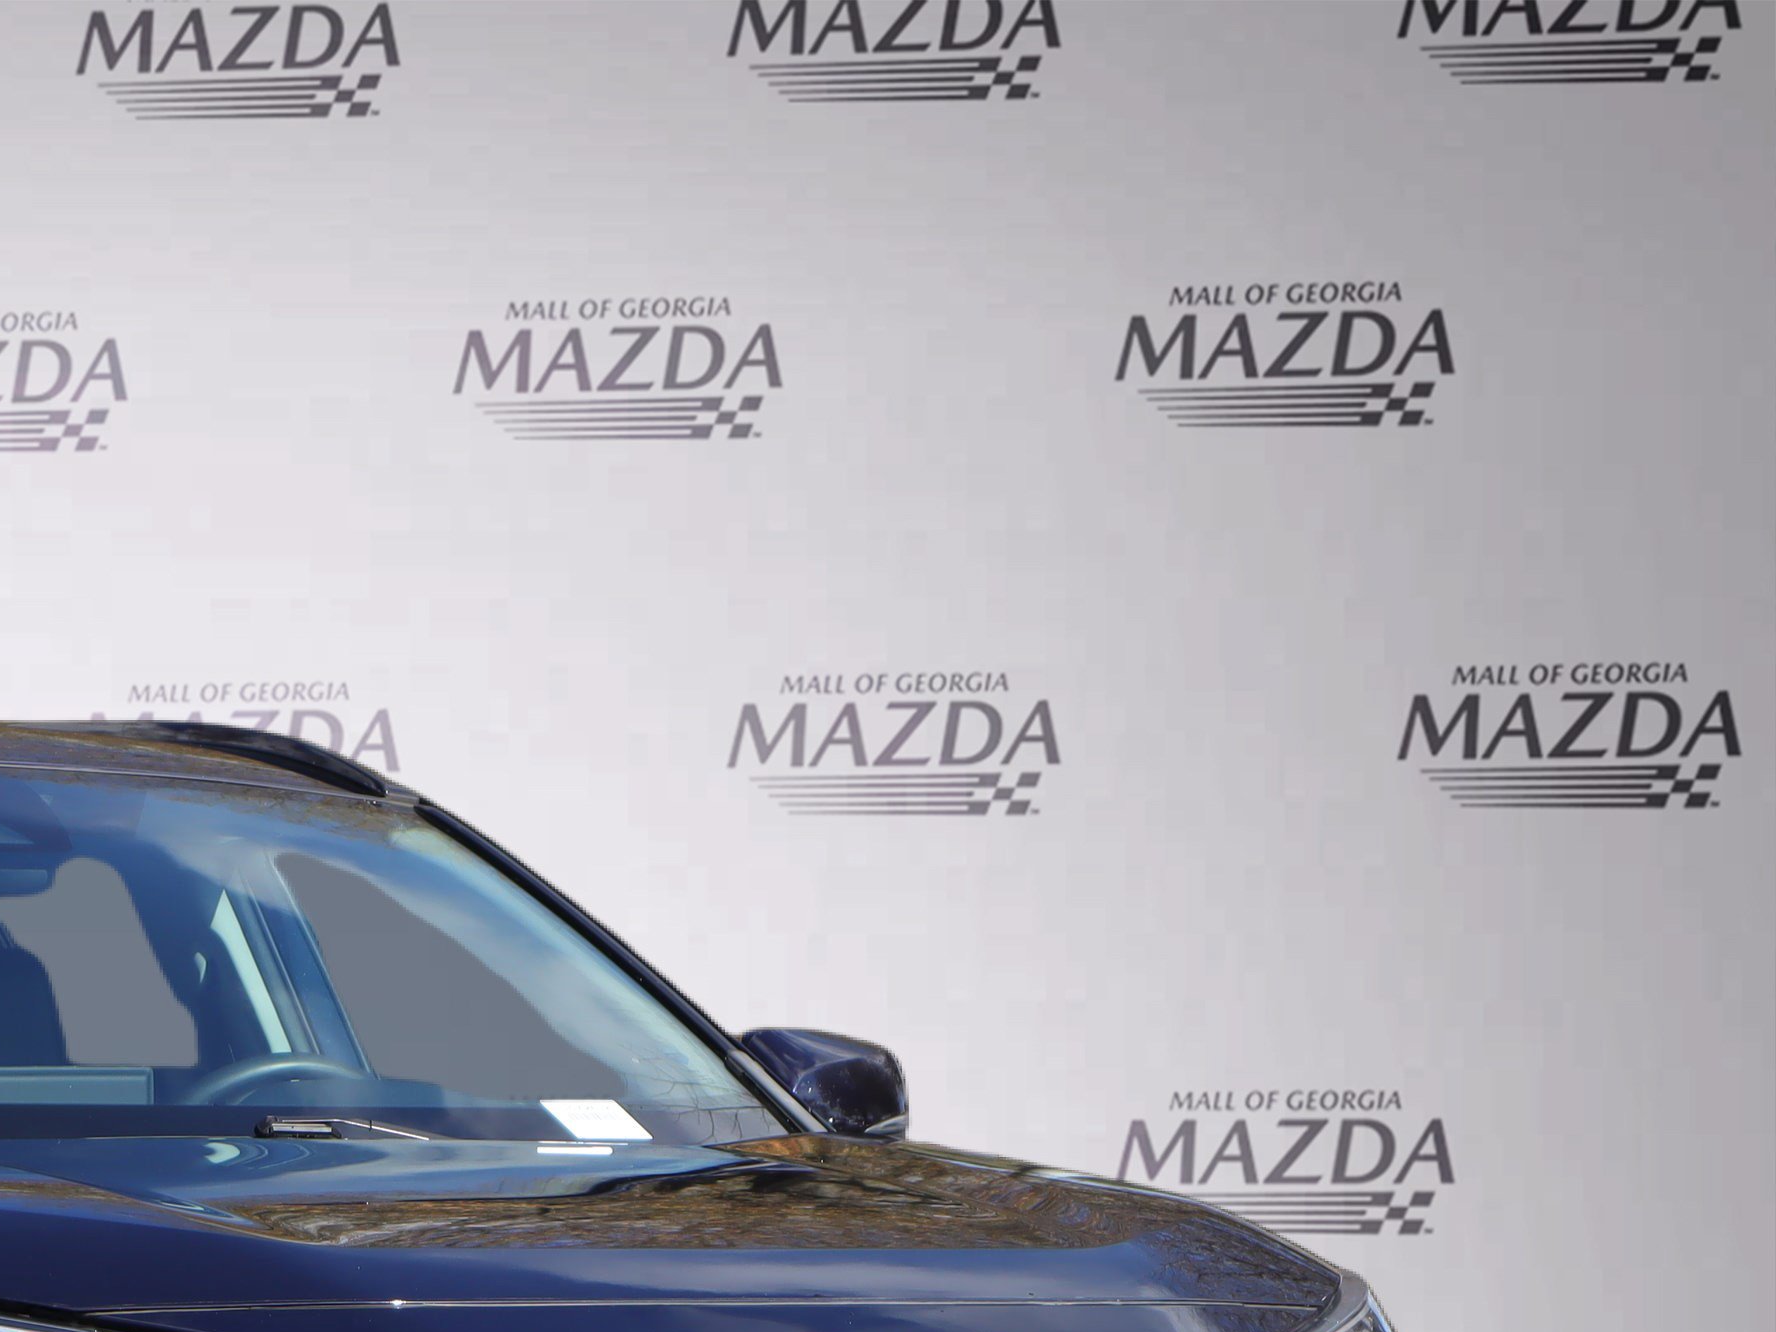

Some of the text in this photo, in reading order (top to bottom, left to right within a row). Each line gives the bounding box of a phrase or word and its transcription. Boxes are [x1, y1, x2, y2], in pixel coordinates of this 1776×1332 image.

[76, 3, 401, 75] MAZDA
[727, 0, 1062, 57] MAZDA
[506, 297, 732, 320] MALL OF GEORGIA
[1170, 281, 1403, 305] MALL OF GEORGIA
[453, 324, 784, 394] MAZDA
[1114, 308, 1455, 381] MAZDA
[128, 682, 350, 703] MALL OF GEORGIA
[781, 672, 1010, 694] MALL OF GEORGIA
[1452, 662, 1689, 685] MALL OF GEORGIA
[727, 699, 1062, 768] MAZDA
[1397, 690, 1743, 760] MAZDA
[1170, 1089, 1403, 1111] MALL OF GEORGIA
[1117, 1118, 1455, 1185] MAZDA
